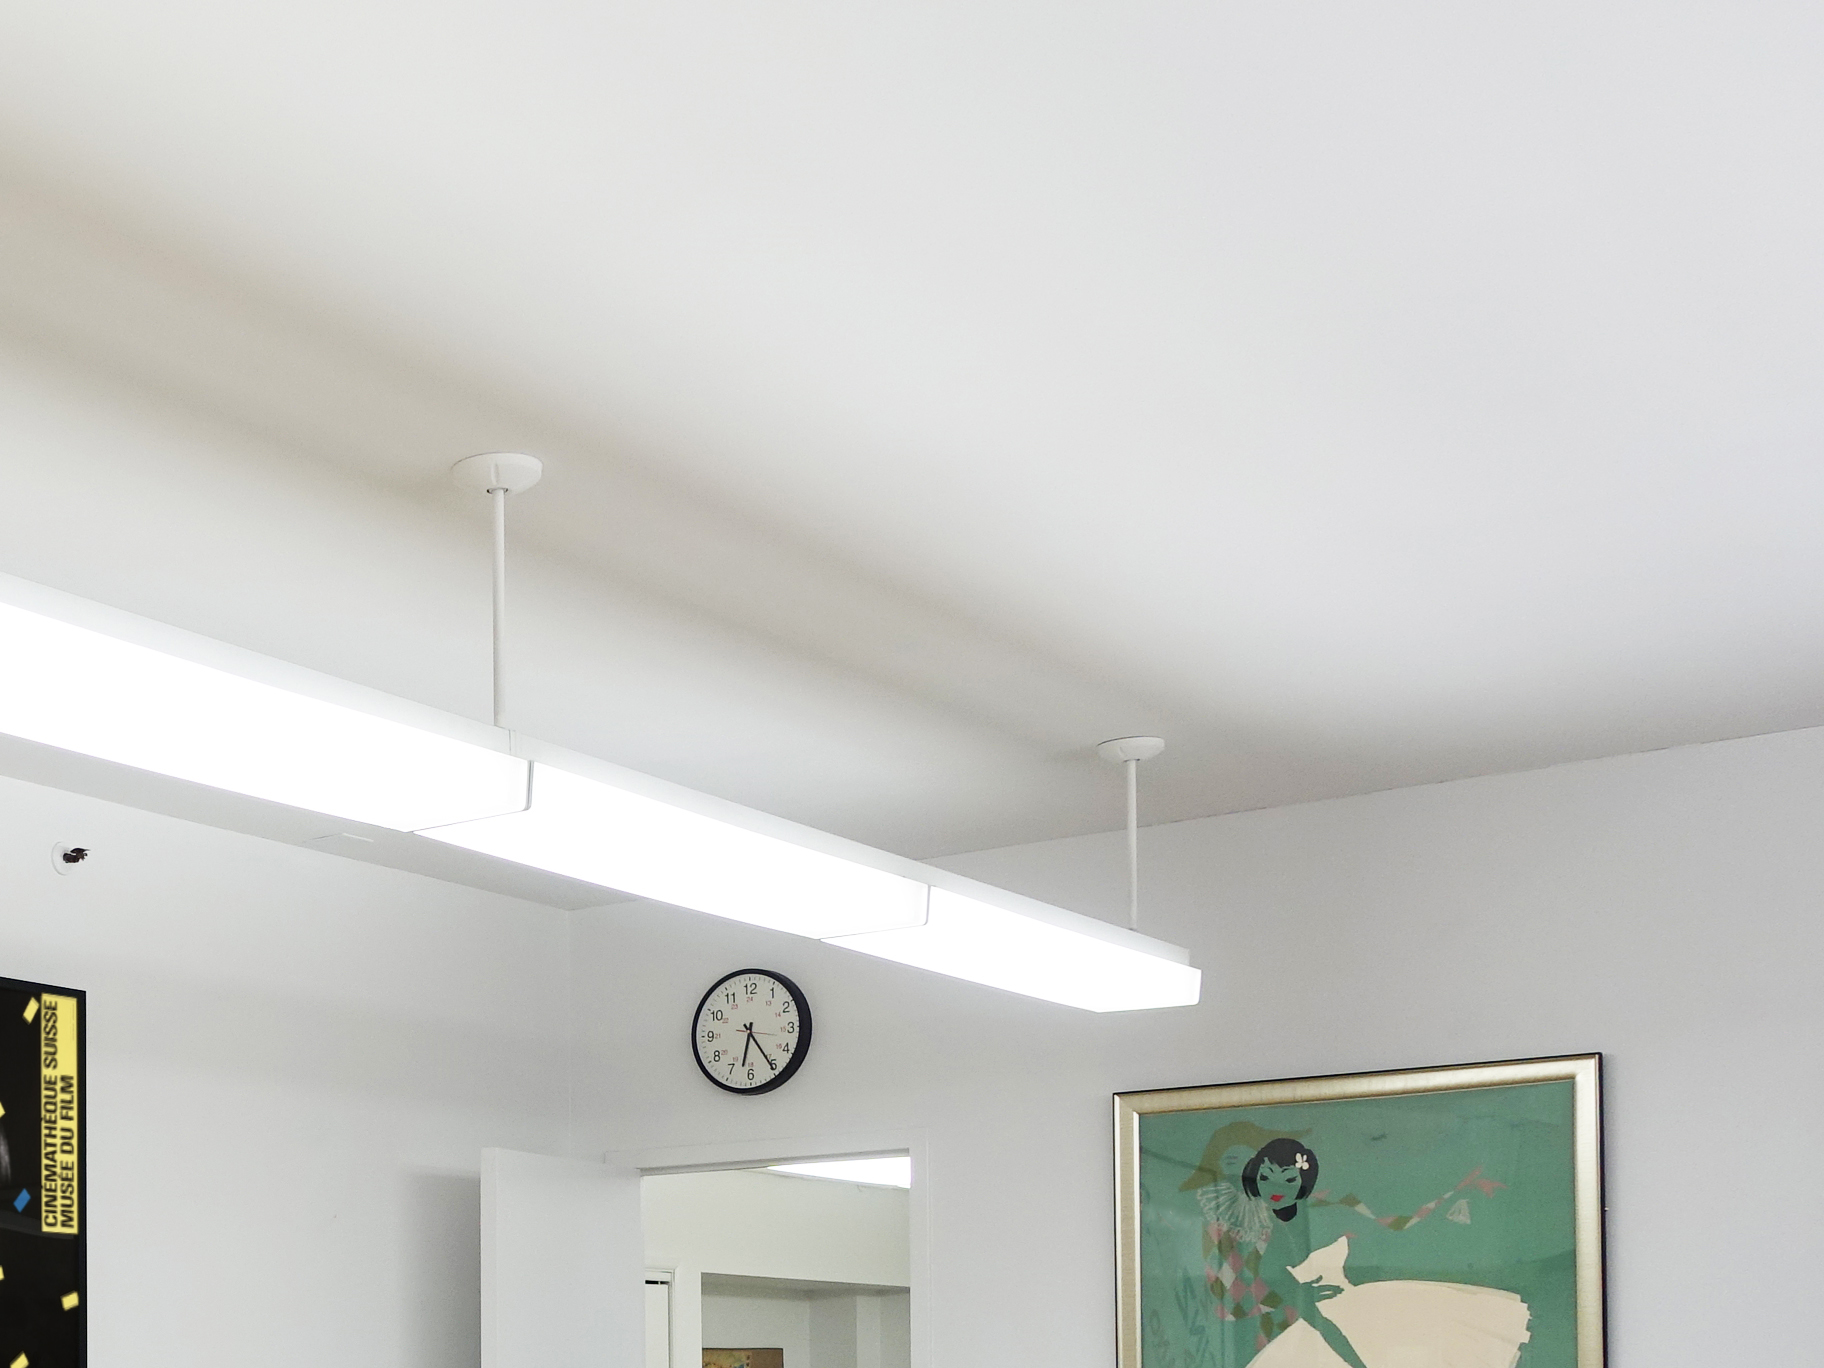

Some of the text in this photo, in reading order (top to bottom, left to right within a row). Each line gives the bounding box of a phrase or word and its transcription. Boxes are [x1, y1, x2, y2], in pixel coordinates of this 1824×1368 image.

[743, 982, 758, 995] 12
[769, 986, 775, 999] 1
[724, 991, 736, 1004] 11
[782, 1001, 790, 1013] 2
[710, 1009, 723, 1021] 10
[787, 1021, 795, 1034] 3
[706, 1030, 714, 1042] 9
[782, 1042, 790, 1053] 4
[713, 1049, 721, 1062] 8
[727, 1063, 735, 1075] 7
[747, 1068, 755, 1080] 6
[40, 999, 58, 1228] CINÉMATHÈQUE SUISSE
[57, 1074, 75, 1229] MUSÉE DU FILM
